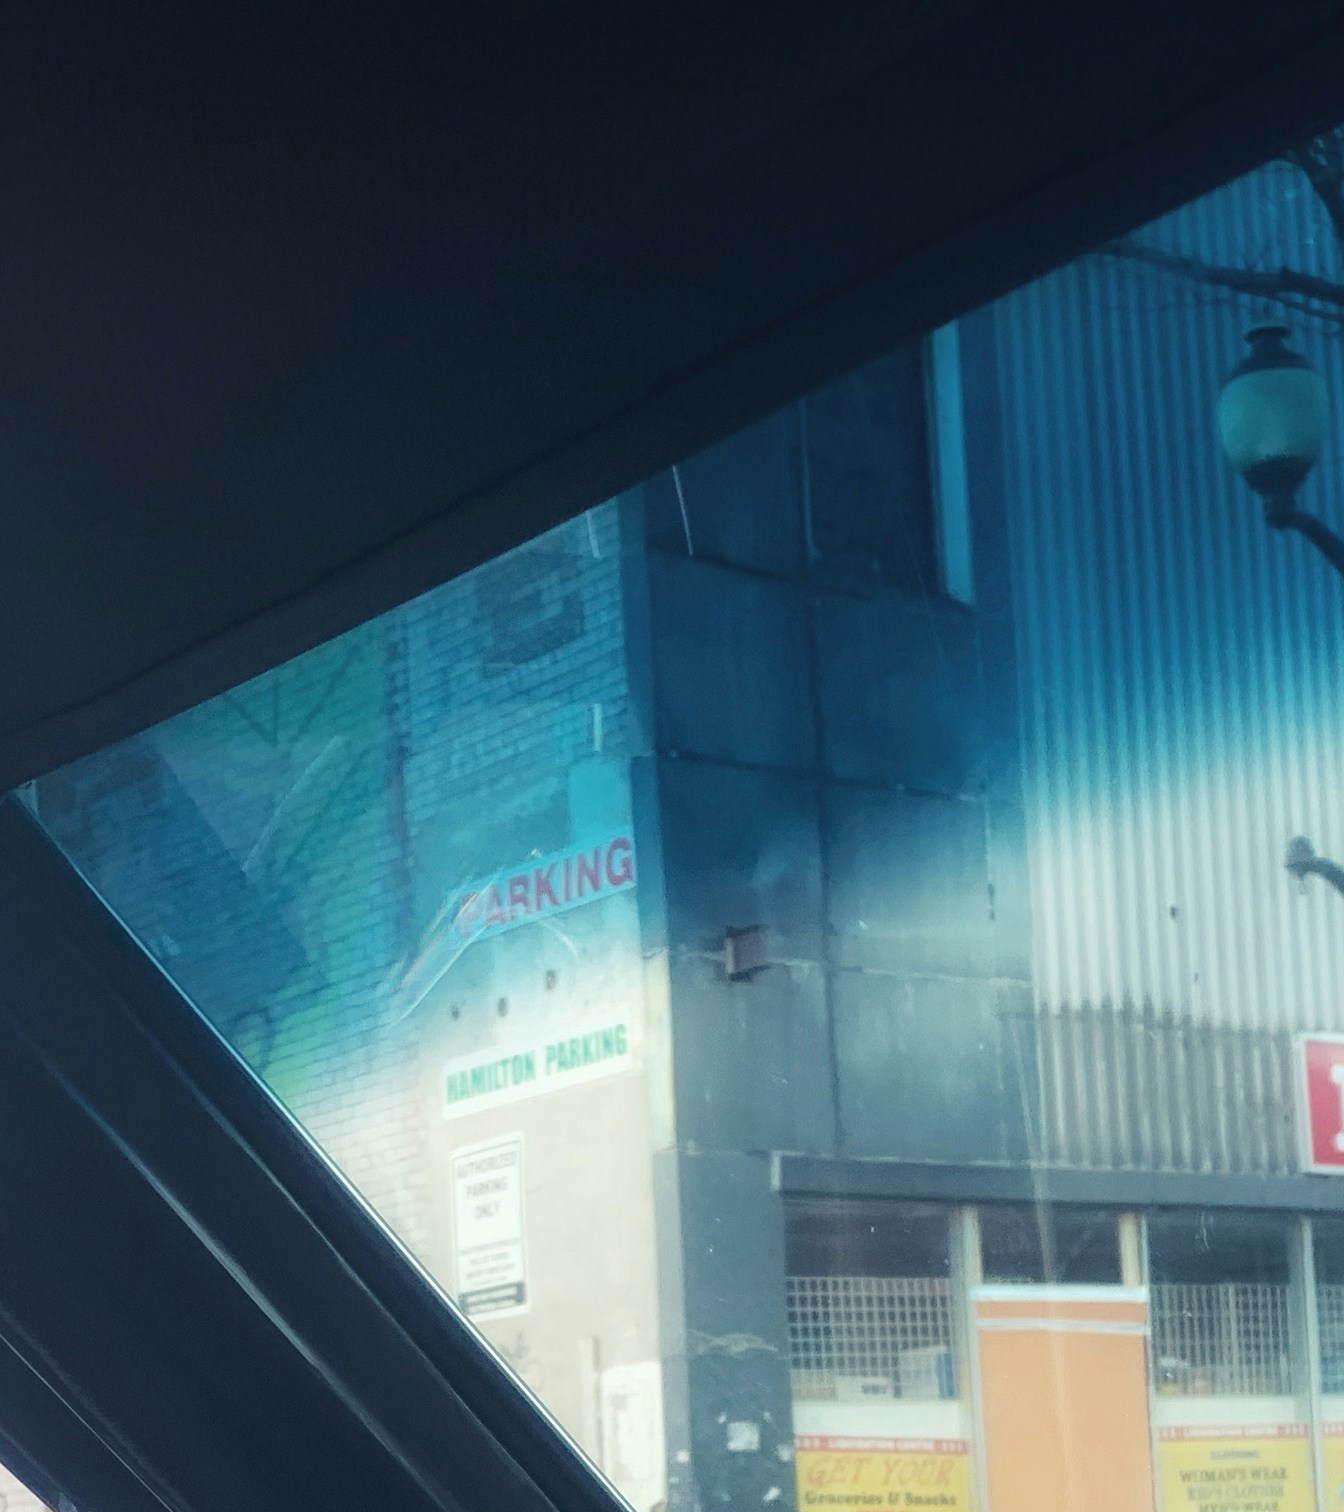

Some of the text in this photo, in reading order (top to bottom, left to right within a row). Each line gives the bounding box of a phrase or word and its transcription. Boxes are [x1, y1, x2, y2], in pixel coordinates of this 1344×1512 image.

[459, 837, 635, 936] PARKING
[446, 1023, 628, 1104] HAMILTON PARKING
[806, 1455, 956, 1487] GET YOUR
